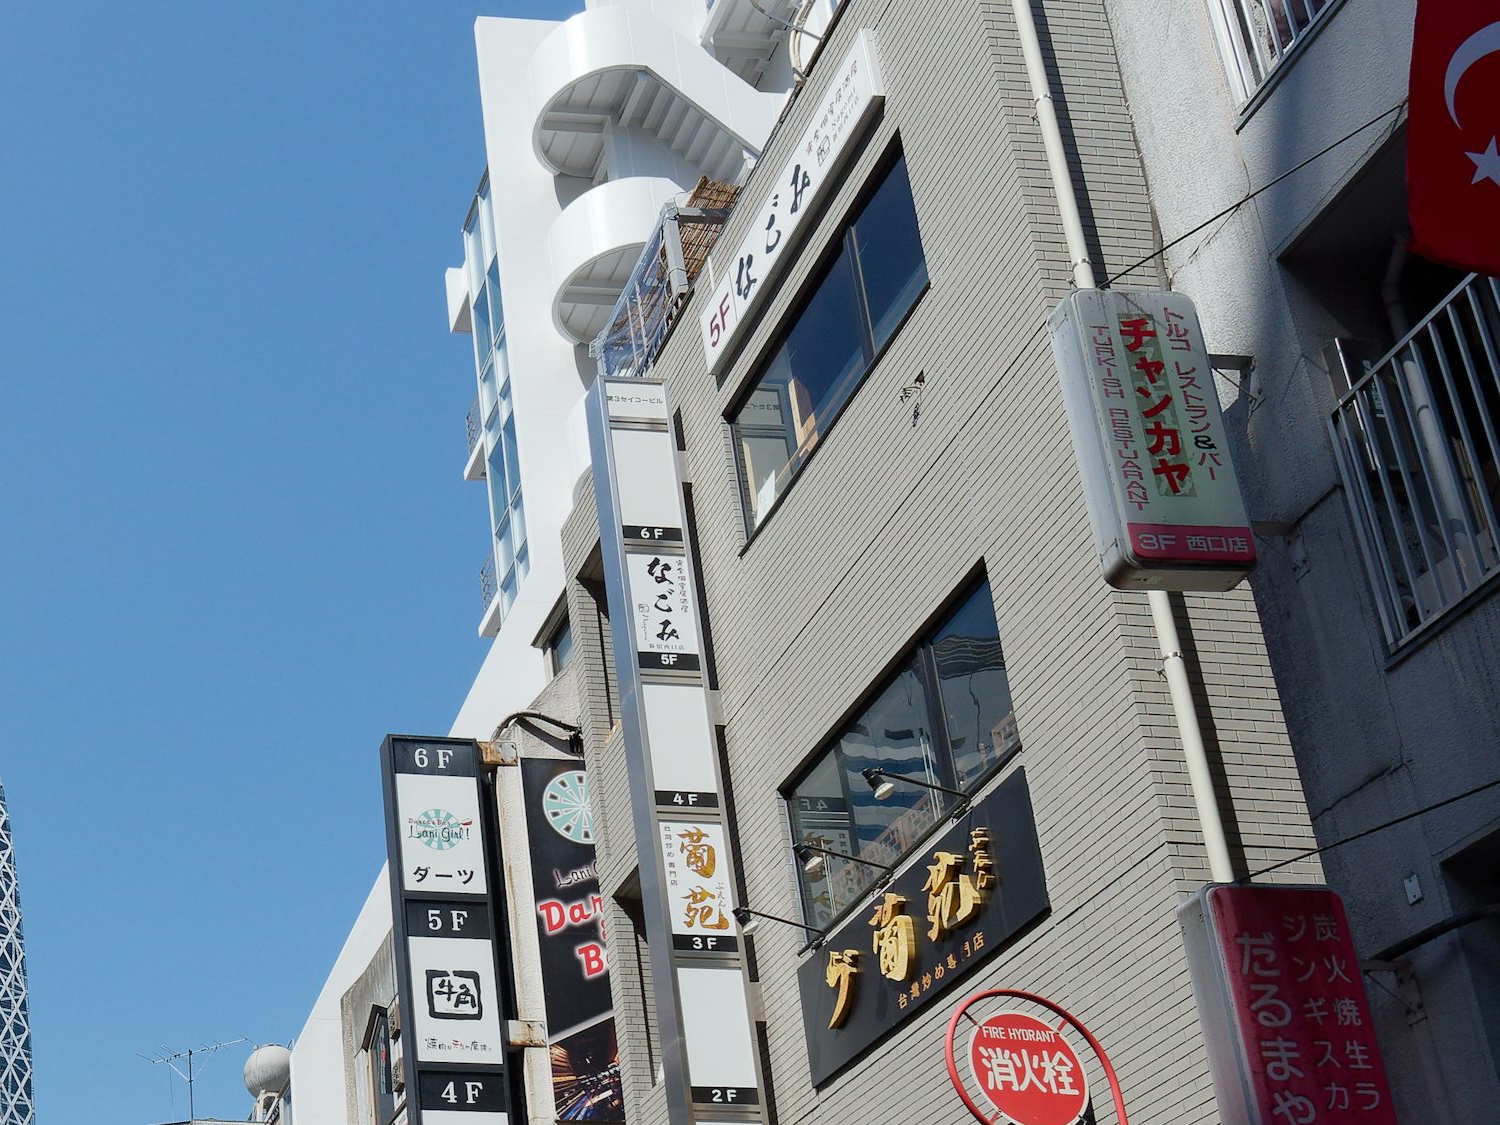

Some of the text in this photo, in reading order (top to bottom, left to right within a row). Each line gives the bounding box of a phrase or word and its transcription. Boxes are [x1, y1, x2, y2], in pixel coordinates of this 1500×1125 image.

[710, 164, 810, 348] 5F なごみ
[1163, 307, 1192, 352] トルコ
[1090, 324, 1125, 399] TURKISH
[1119, 318, 1190, 496] チャンカヤ
[640, 527, 663, 540] 6F
[1139, 533, 1249, 553] 3F 西口店
[646, 557, 679, 642] なごみ
[660, 653, 678, 666] 5F
[414, 747, 453, 769] 6F
[672, 793, 698, 806] 4F
[408, 825, 438, 838] Lani
[413, 865, 474, 885] ダーツ
[555, 866, 592, 888] Lani
[427, 909, 468, 931] 5F
[693, 937, 718, 950] 3F
[435, 978, 476, 1010] 牛角
[982, 1026, 1057, 1043] FIRE HYDRANT
[978, 1046, 1080, 1096] 消火栓
[441, 1082, 483, 1105] 4F
[712, 1089, 736, 1102] 2F
